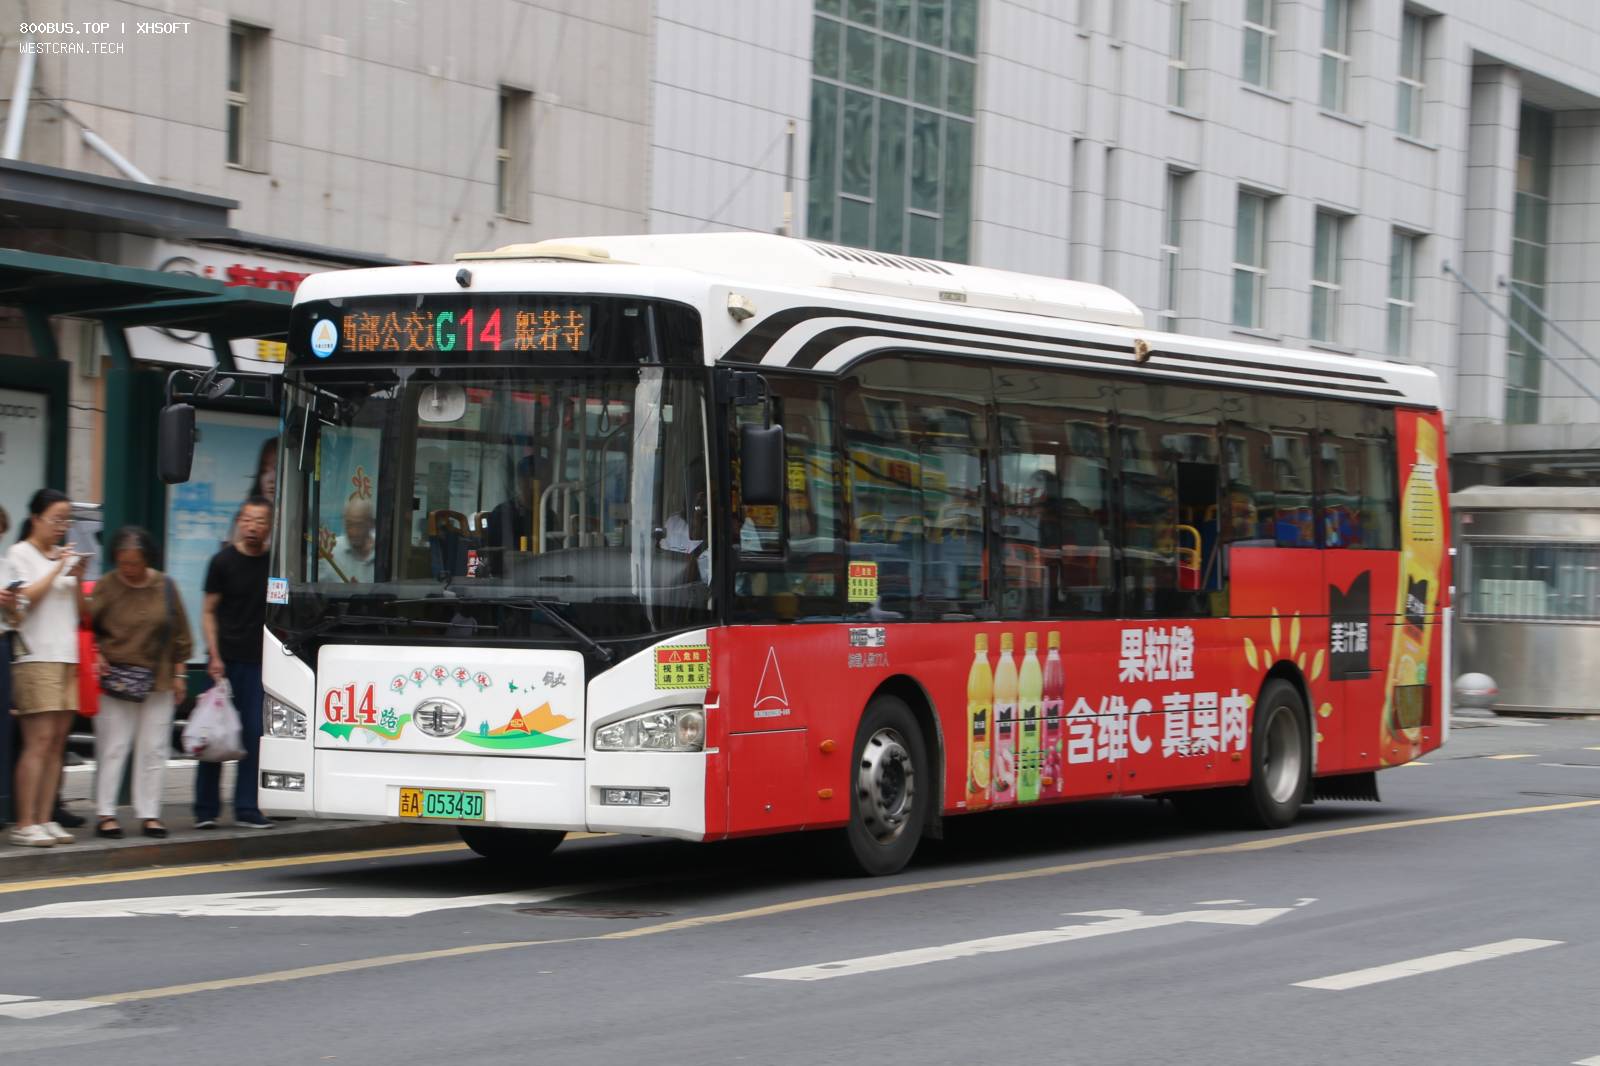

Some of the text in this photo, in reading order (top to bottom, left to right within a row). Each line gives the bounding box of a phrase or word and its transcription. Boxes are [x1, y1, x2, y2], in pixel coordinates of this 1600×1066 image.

[514, 310, 584, 351] 般若寺
[1119, 626, 1194, 683] 果粒橙
[1331, 622, 1368, 653] 美汁源
[663, 663, 705, 673] 视线盲区
[663, 674, 705, 683] 请勿靠近
[1067, 688, 1249, 764] 含维C 真果肉
